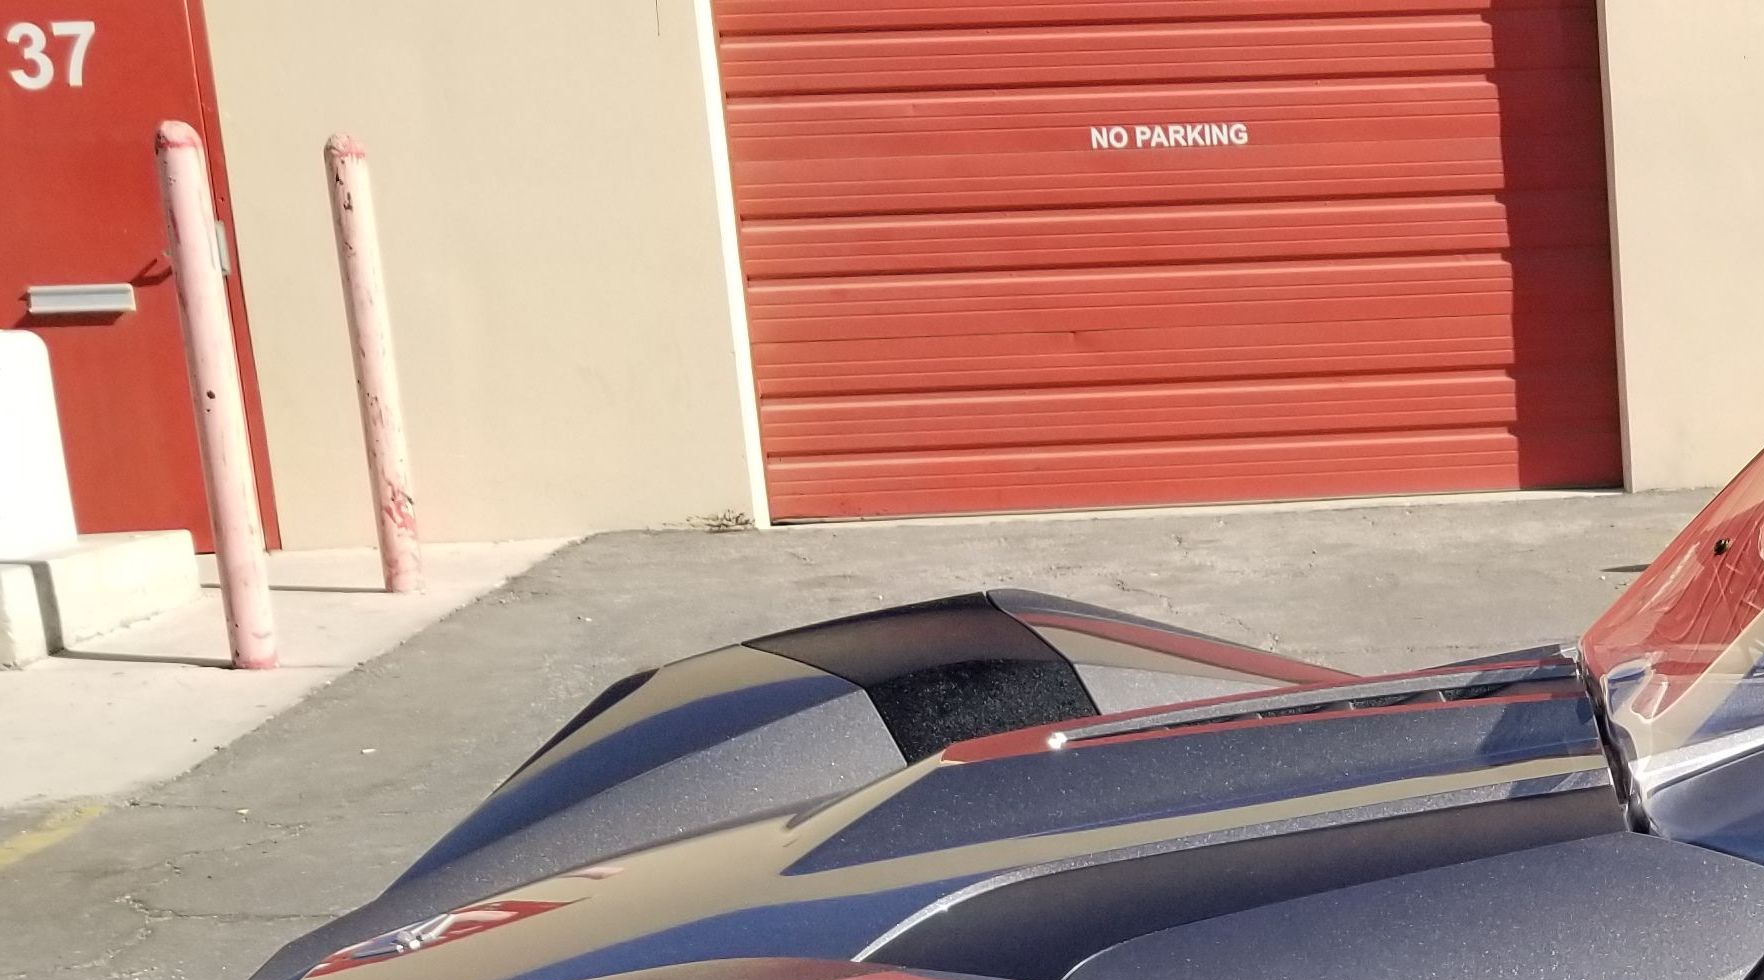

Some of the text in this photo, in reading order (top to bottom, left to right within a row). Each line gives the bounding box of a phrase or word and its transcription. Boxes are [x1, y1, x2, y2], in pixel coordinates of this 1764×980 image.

[6, 20, 96, 91] 37
[1090, 122, 1249, 150] NO PARKING
